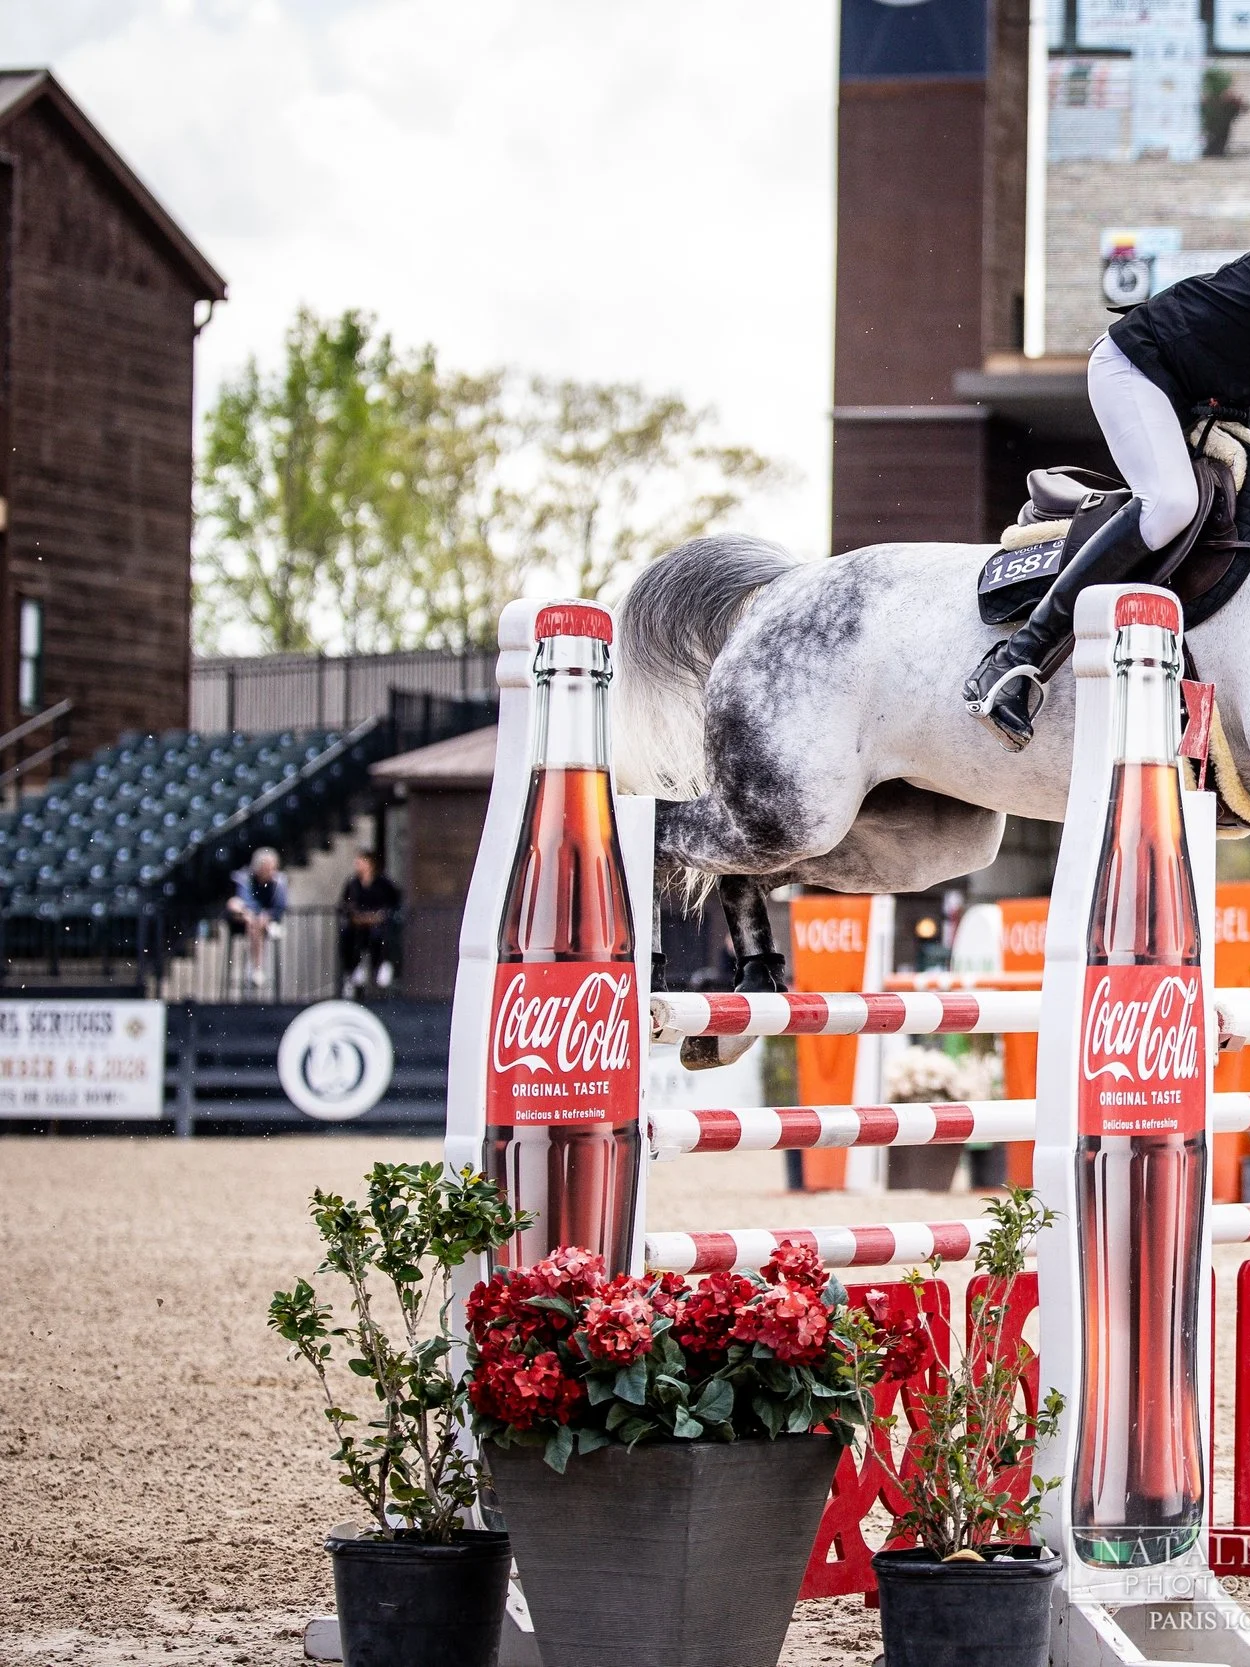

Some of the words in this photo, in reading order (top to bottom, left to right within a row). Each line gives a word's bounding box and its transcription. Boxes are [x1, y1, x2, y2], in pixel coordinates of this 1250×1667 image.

[988, 549, 1061, 585] 1587
[794, 918, 864, 953] VOGEL
[493, 972, 632, 1075] Coca-Cola
[1083, 976, 1199, 1083] Coca-Cola
[512, 1083, 569, 1097] ORIGINAL
[573, 1081, 610, 1095] TASTE
[1099, 1091, 1147, 1106] ORIGINAL
[1151, 1090, 1181, 1104] TASTE
[515, 1110, 552, 1120] Delicious
[554, 1109, 560, 1119] &
[562, 1108, 606, 1119] Refreshing
[1103, 1119, 1134, 1130] Delicious
[1135, 1119, 1141, 1130] &
[1142, 1118, 1178, 1130] Refreshing
